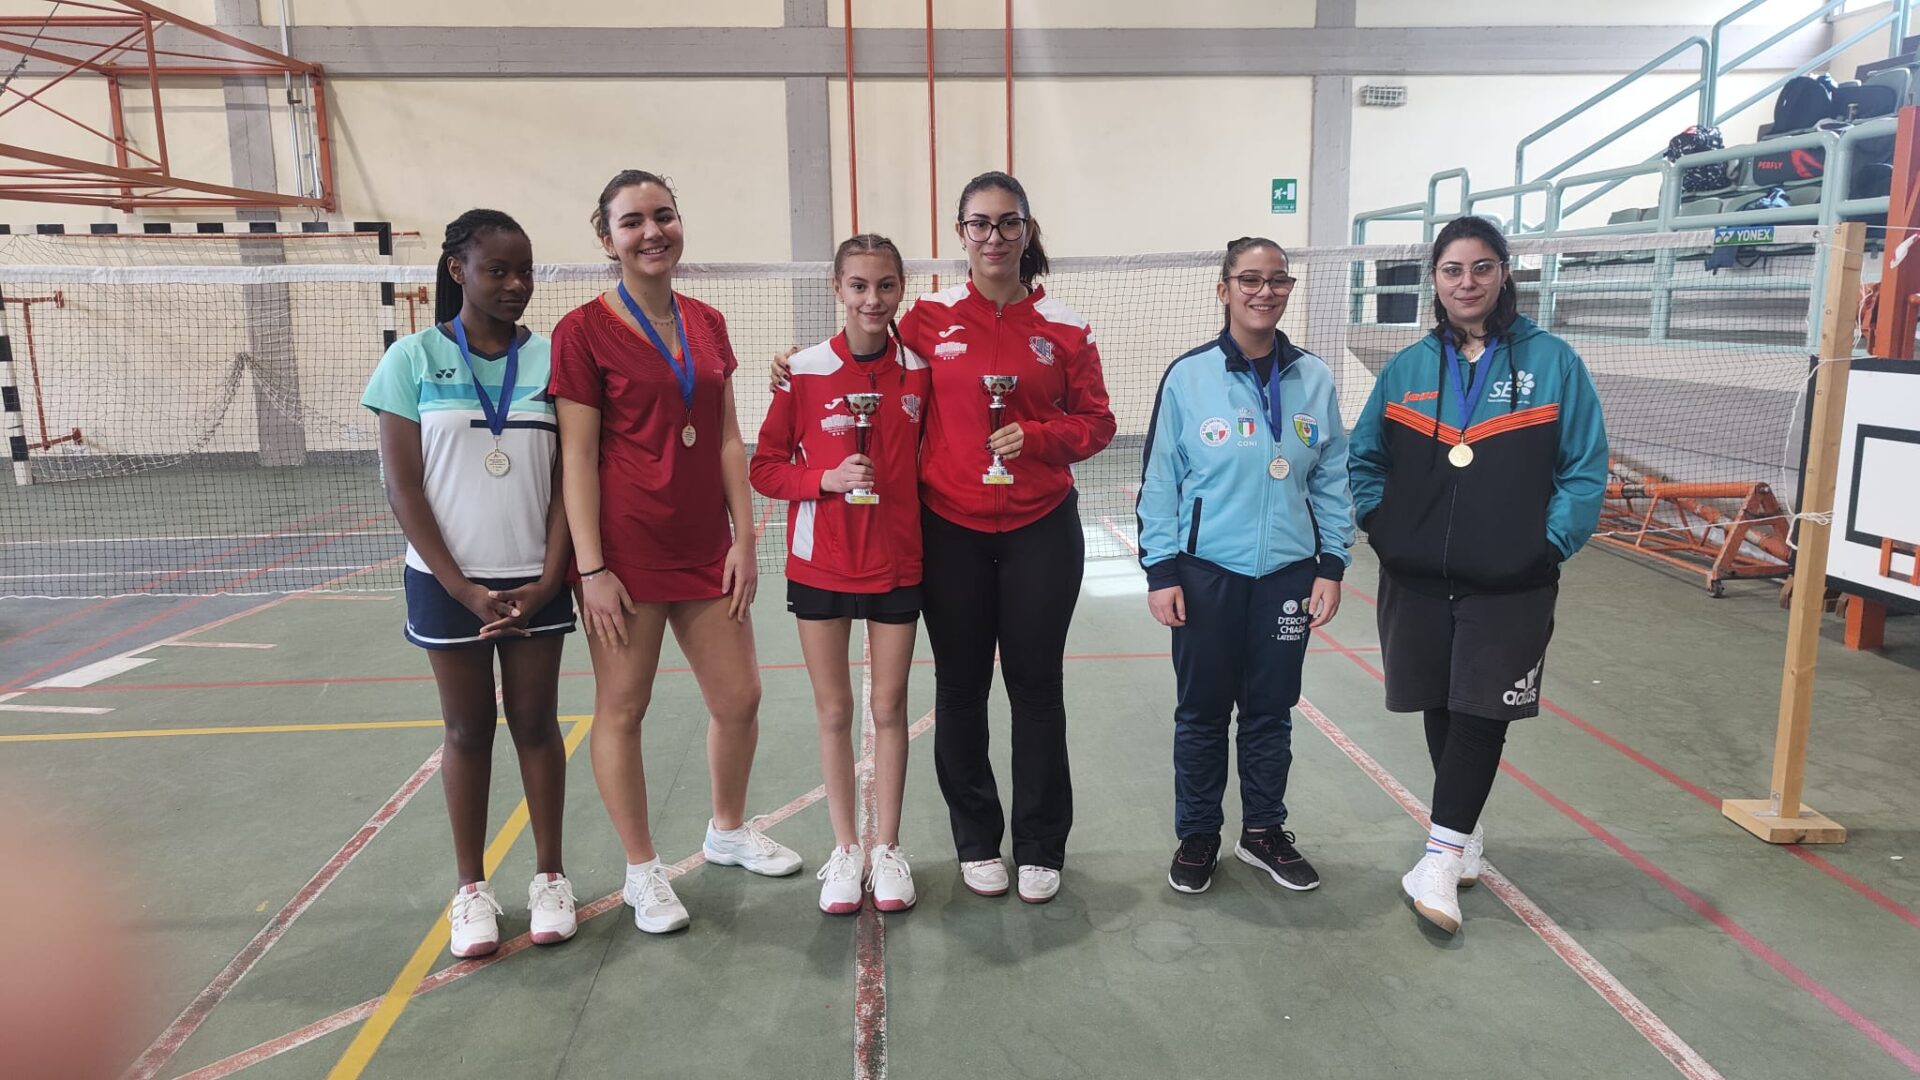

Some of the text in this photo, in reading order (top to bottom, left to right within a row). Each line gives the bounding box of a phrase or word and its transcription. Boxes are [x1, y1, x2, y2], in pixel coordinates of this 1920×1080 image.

[1737, 229, 1771, 241] YONEX
[1277, 616, 1308, 625] D'ERCH
[1502, 687, 1537, 706] adas
